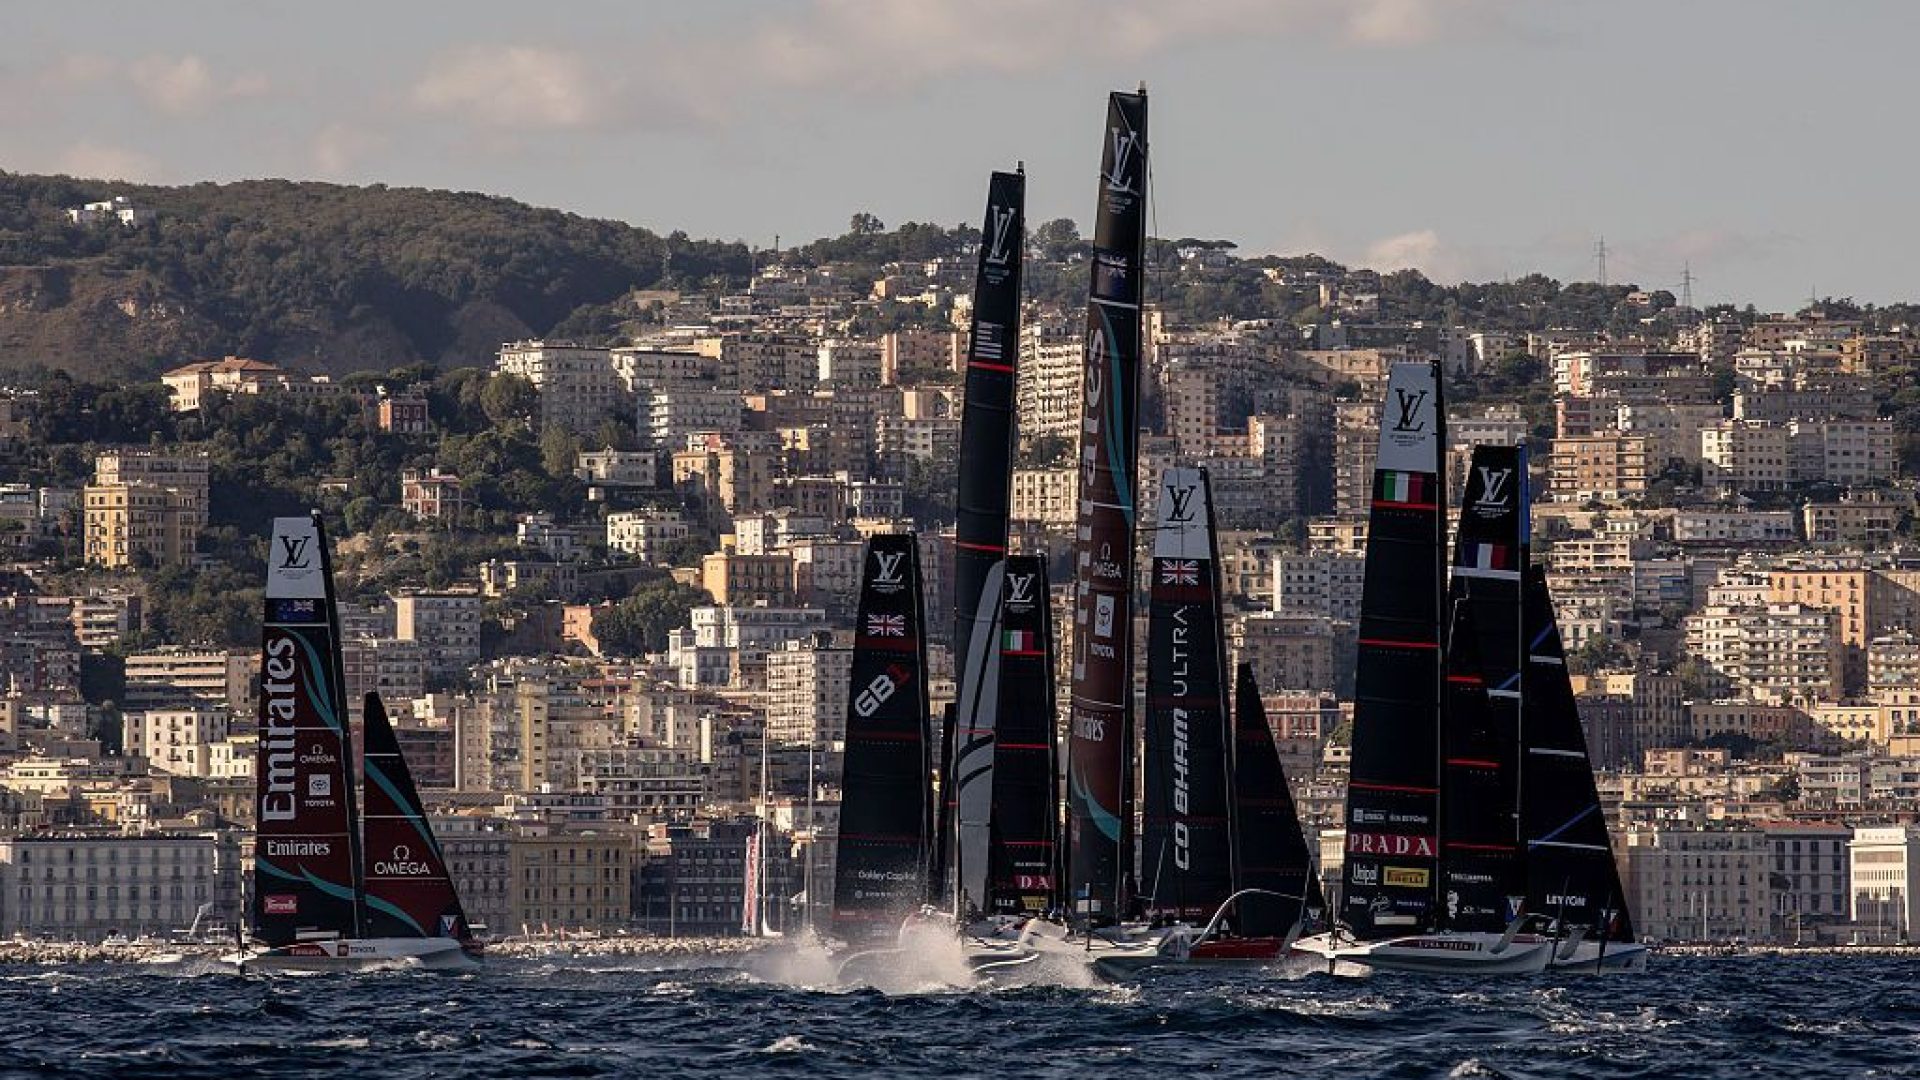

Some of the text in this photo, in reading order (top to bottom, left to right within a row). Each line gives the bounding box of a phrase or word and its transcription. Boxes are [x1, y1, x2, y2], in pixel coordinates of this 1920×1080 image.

[261, 636, 296, 822] Emirates
[300, 754, 336, 764] OMEGA
[267, 840, 330, 856] Emirates
[1351, 833, 1432, 856] PRADA
[374, 861, 430, 875] OMEGA
[858, 870, 886, 882] Oakley
